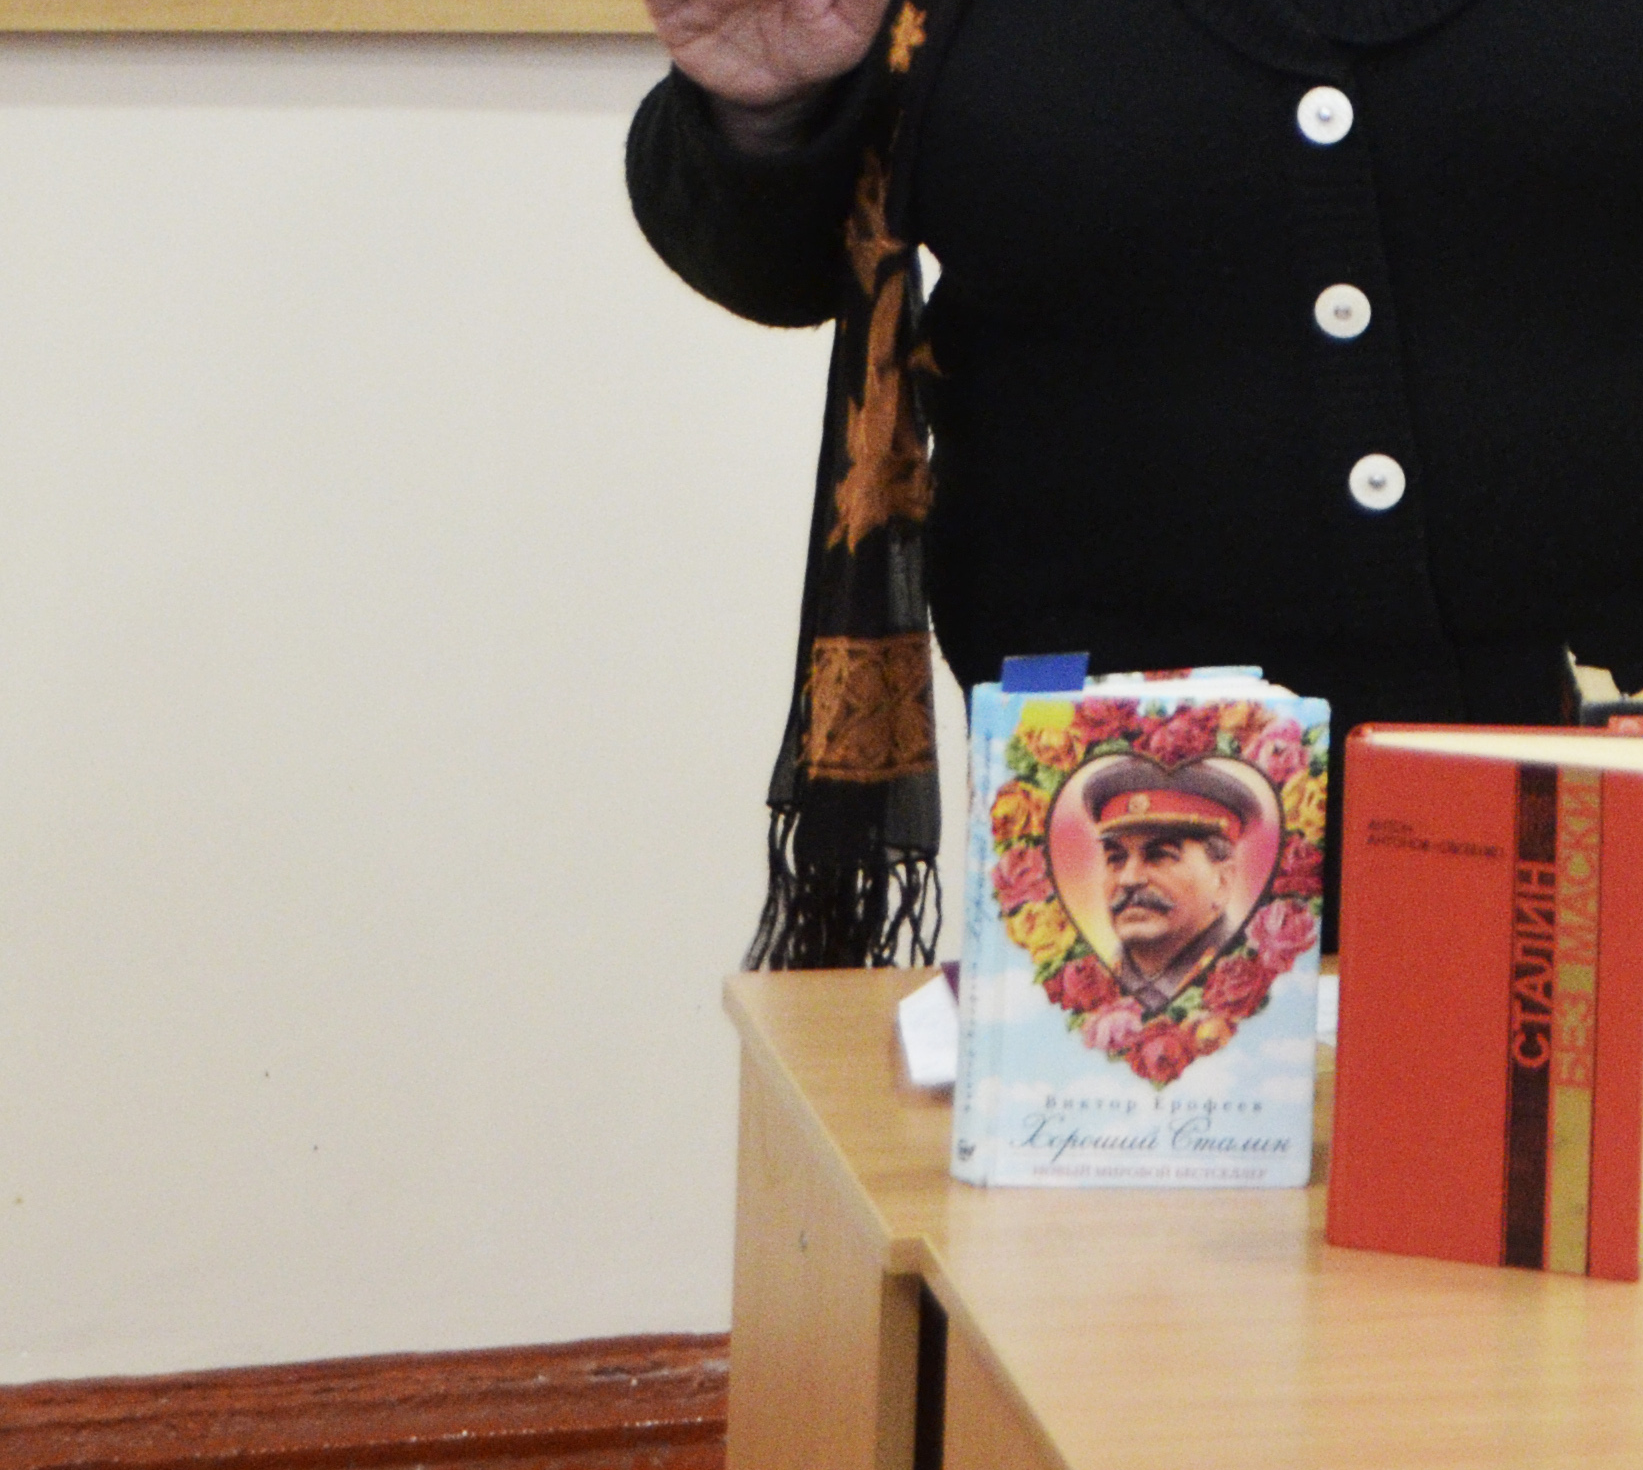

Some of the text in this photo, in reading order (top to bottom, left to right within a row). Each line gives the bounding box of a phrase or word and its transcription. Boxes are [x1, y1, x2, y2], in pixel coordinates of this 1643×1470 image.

[1555, 783, 1601, 964] МАСКИ
[1512, 860, 1556, 1069] СТАЛИН
[1552, 992, 1597, 1087] БЕЗ
[1009, 1113, 1159, 1162] Хороший
[1168, 1114, 1292, 1154] Сталин
[1045, 1093, 1263, 1116] Виктор Ерофеев
